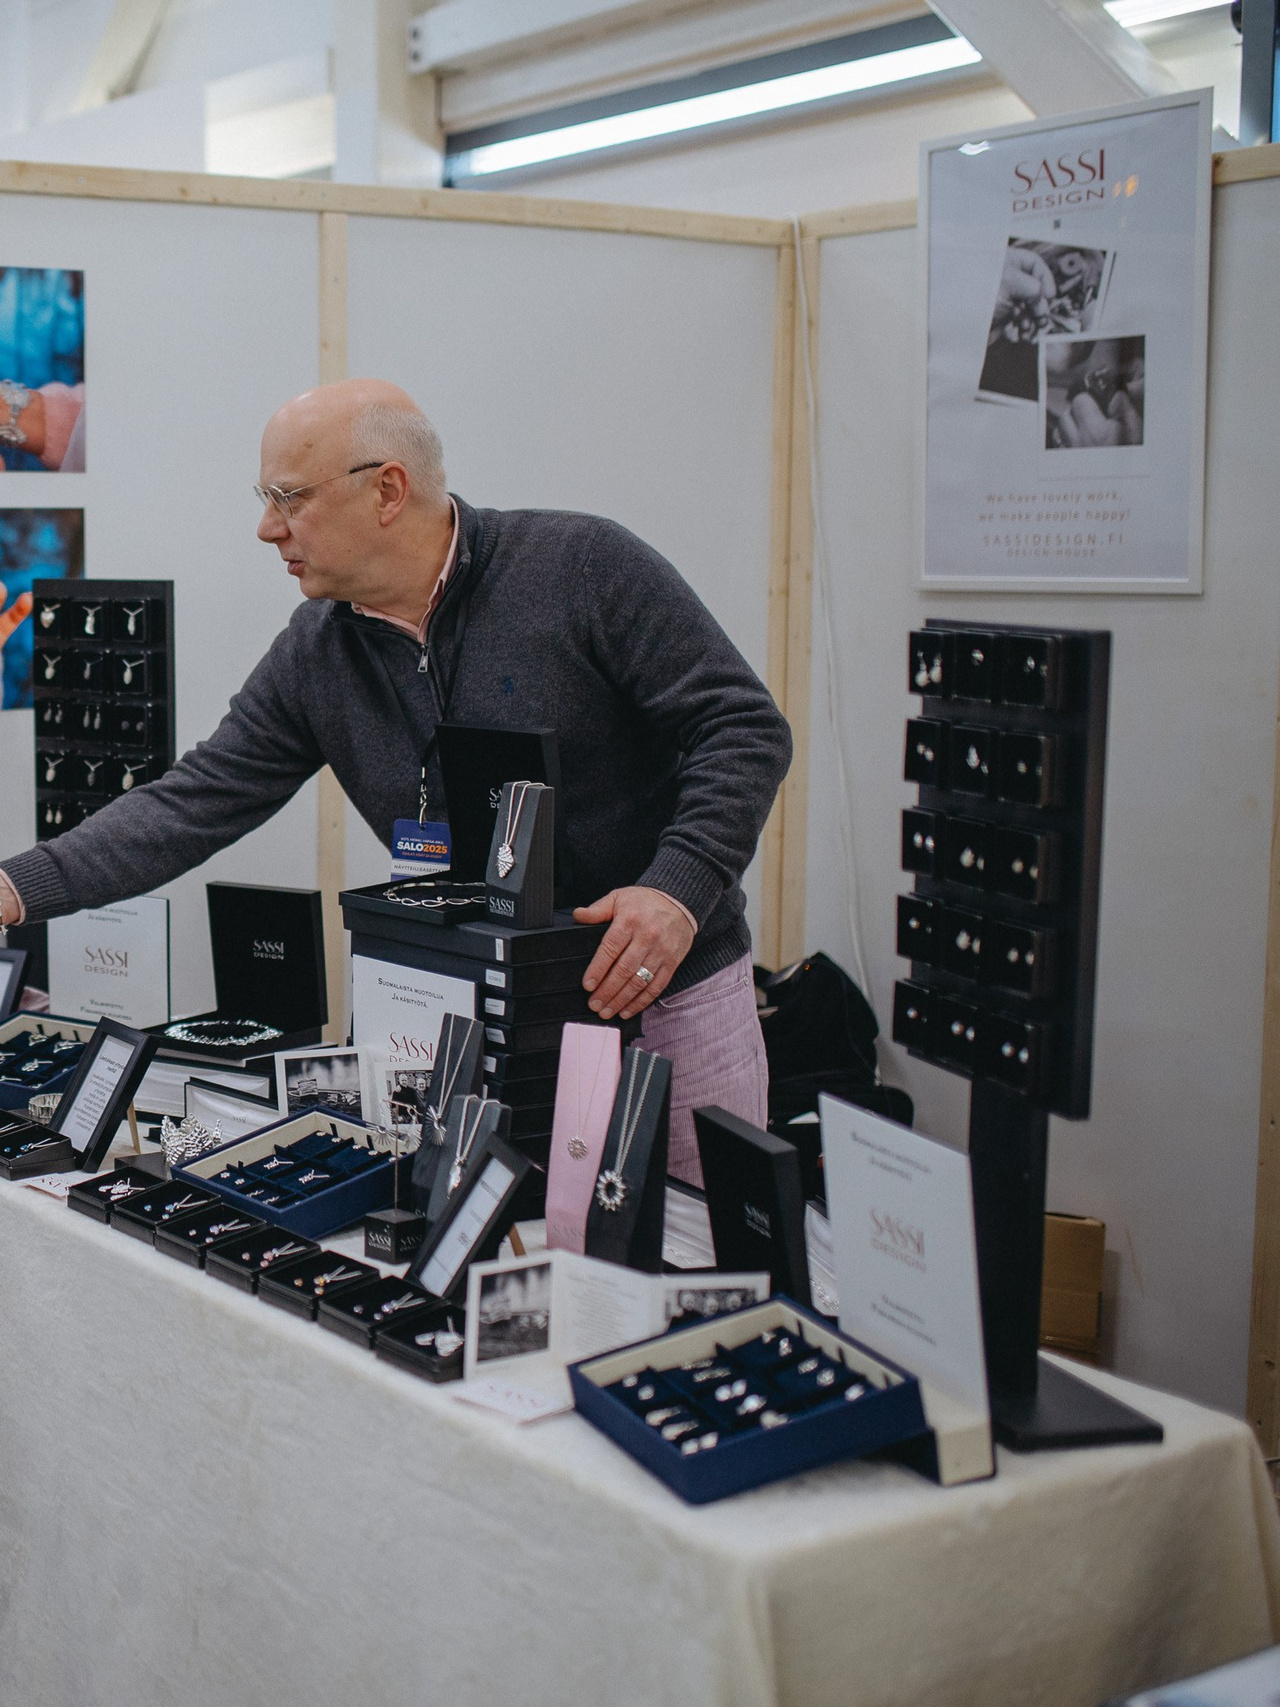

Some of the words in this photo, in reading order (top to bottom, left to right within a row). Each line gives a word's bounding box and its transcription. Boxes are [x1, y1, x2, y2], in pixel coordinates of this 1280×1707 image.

[1010, 149, 1104, 195] SASSI
[1013, 187, 1104, 212] DESIGN
[1009, 492, 1037, 502] have
[1043, 491, 1081, 503] lovely
[1037, 511, 1079, 521] people
[397, 841, 448, 854] SALO2025
[489, 896, 514, 913] SASSI
[253, 940, 284, 953] SASSI
[85, 946, 128, 968] SASSI
[253, 952, 284, 960] DESIGN
[85, 965, 128, 977] DESIGN
[414, 988, 444, 1000] MUOTOILUA
[388, 1032, 432, 1061] SASSI
[369, 1232, 391, 1247] SASSI
[869, 1207, 925, 1260] SASSI
